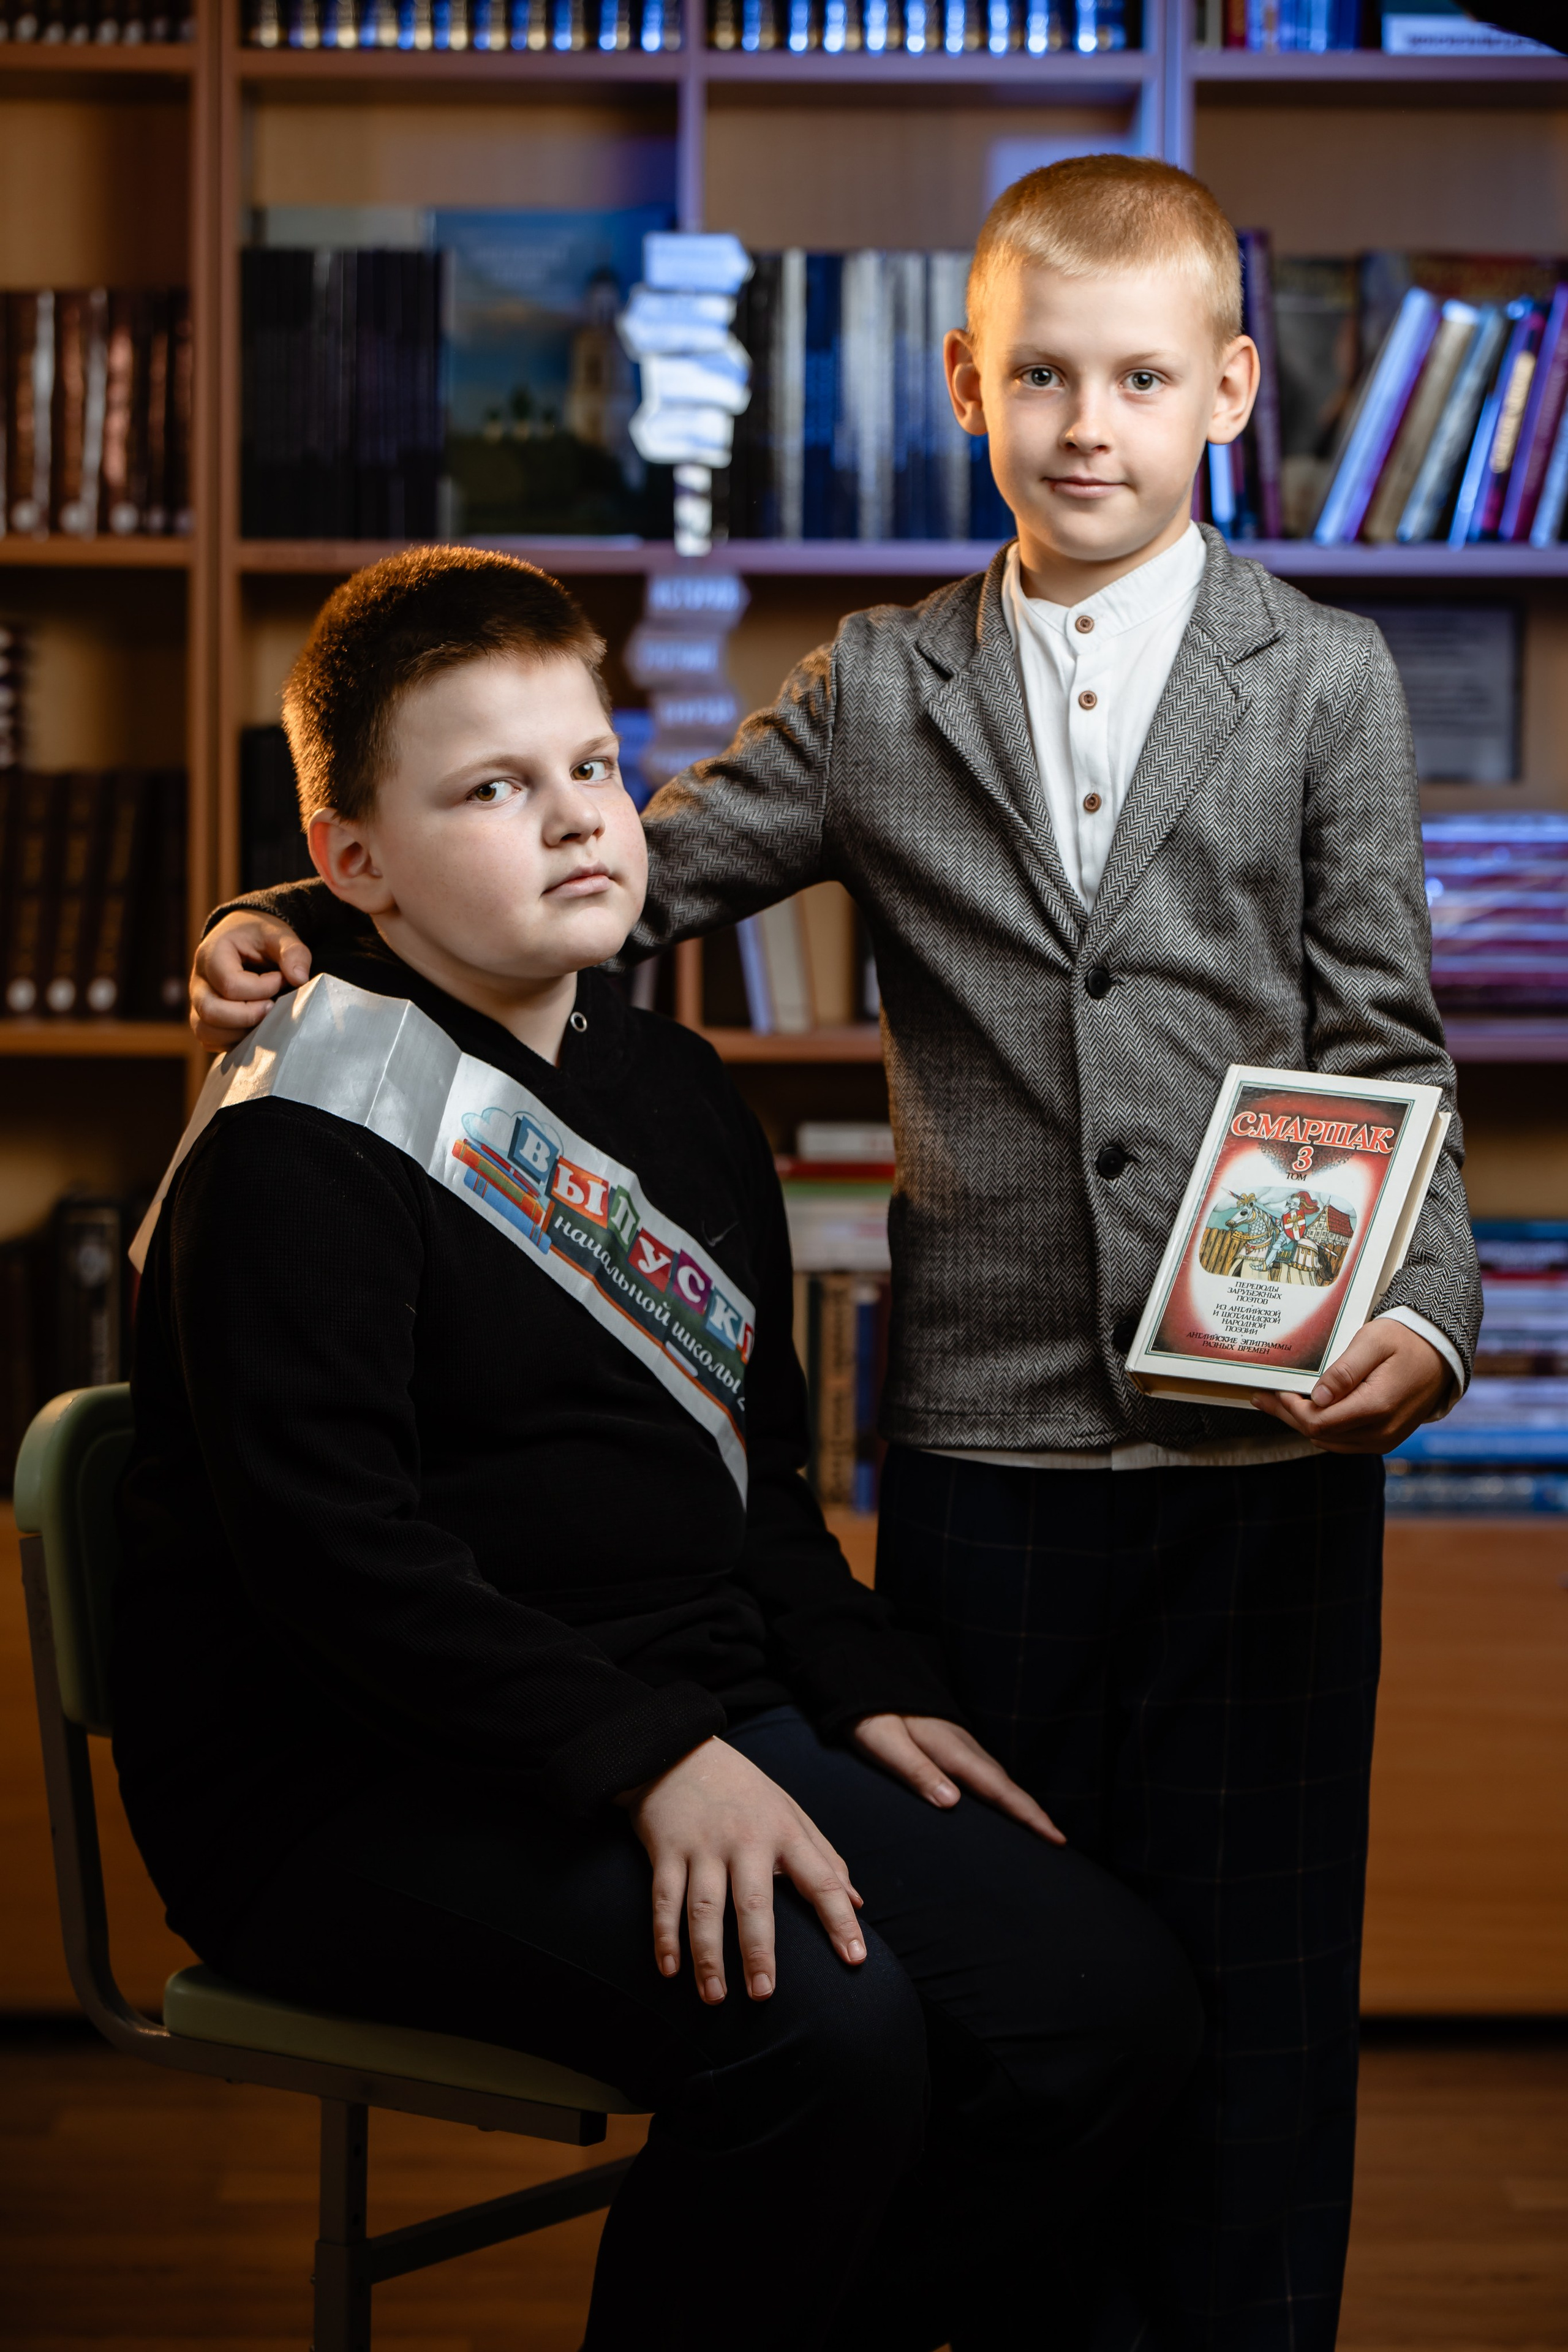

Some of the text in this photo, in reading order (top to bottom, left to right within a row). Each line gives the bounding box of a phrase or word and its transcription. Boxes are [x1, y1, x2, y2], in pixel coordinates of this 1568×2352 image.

[1231, 1111, 1395, 1154] С.МАРШАК
[1292, 1145, 1314, 1172] 3
[1286, 1172, 1306, 1182] ТОМ
[1235, 1281, 1279, 1292] ПЕРЕВОДЫ
[1227, 1287, 1283, 1300] ЗАРУБЕЖНЫХ
[1236, 1295, 1268, 1305] ПОЭТОВ
[554, 1215, 671, 1326] начальной
[671, 1321, 741, 1393] школы
[1221, 1311, 1281, 1324] ШОТЛАНДСКОЙ
[1228, 1306, 1281, 1317] АНГЛИЙСКОЙ
[1222, 1318, 1266, 1329] НАРОДНОЙ
[1225, 1325, 1258, 1335] ПОЭЗИИ
[1186, 1332, 1292, 1351] АНГЛИЙСКИЕ ЭПИГРАММЫ
[1202, 1340, 1270, 1355] РАЗНЫХ ВРЕМЕН
